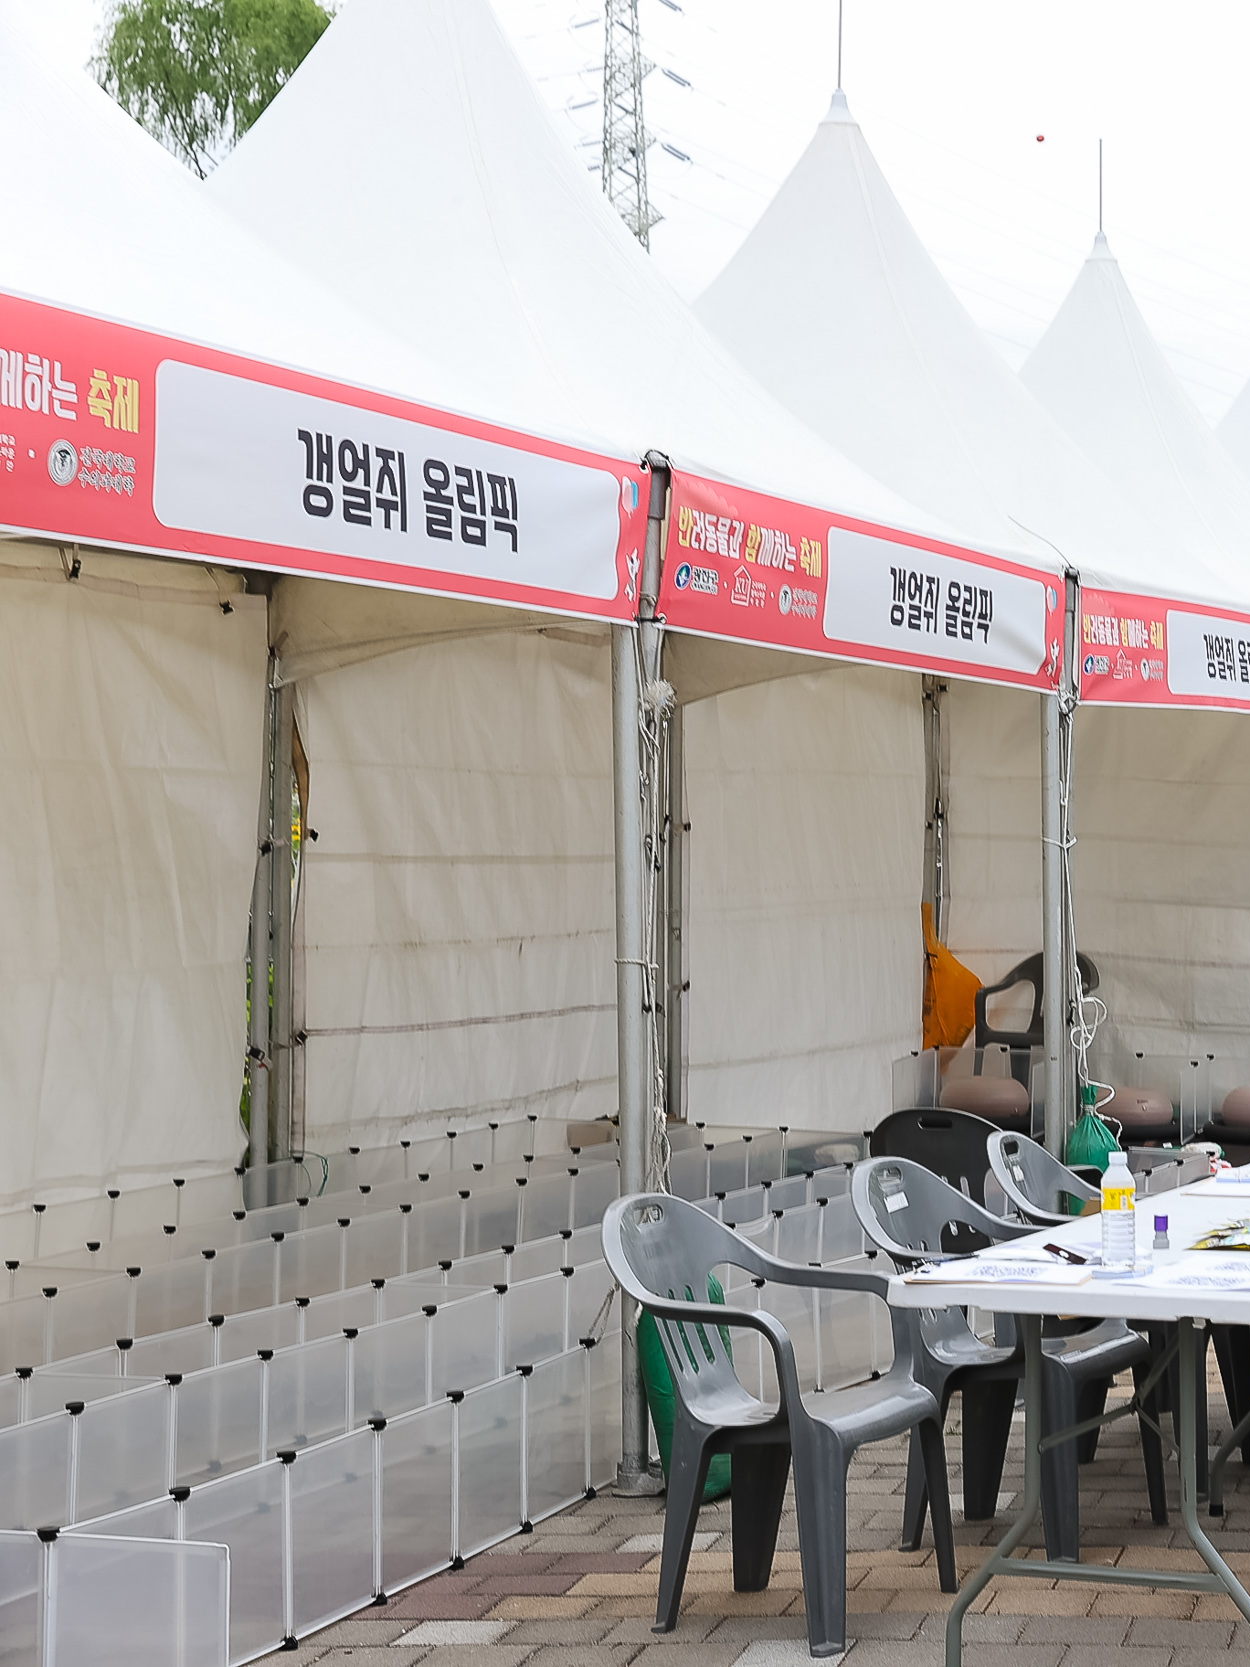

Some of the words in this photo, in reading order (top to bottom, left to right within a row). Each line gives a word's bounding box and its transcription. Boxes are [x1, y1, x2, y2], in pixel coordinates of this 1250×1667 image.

[88, 368, 140, 434] 축제
[297, 427, 407, 533] 갱얼쥐
[423, 458, 519, 554] 올림픽
[679, 505, 745, 560] 반려동물과
[745, 523, 797, 573] 함께하는
[800, 536, 822, 579] 축제
[889, 566, 940, 634] 갱얼쥐
[945, 580, 993, 645] 올림픽
[1203, 633, 1237, 683] 갱얼쥐
